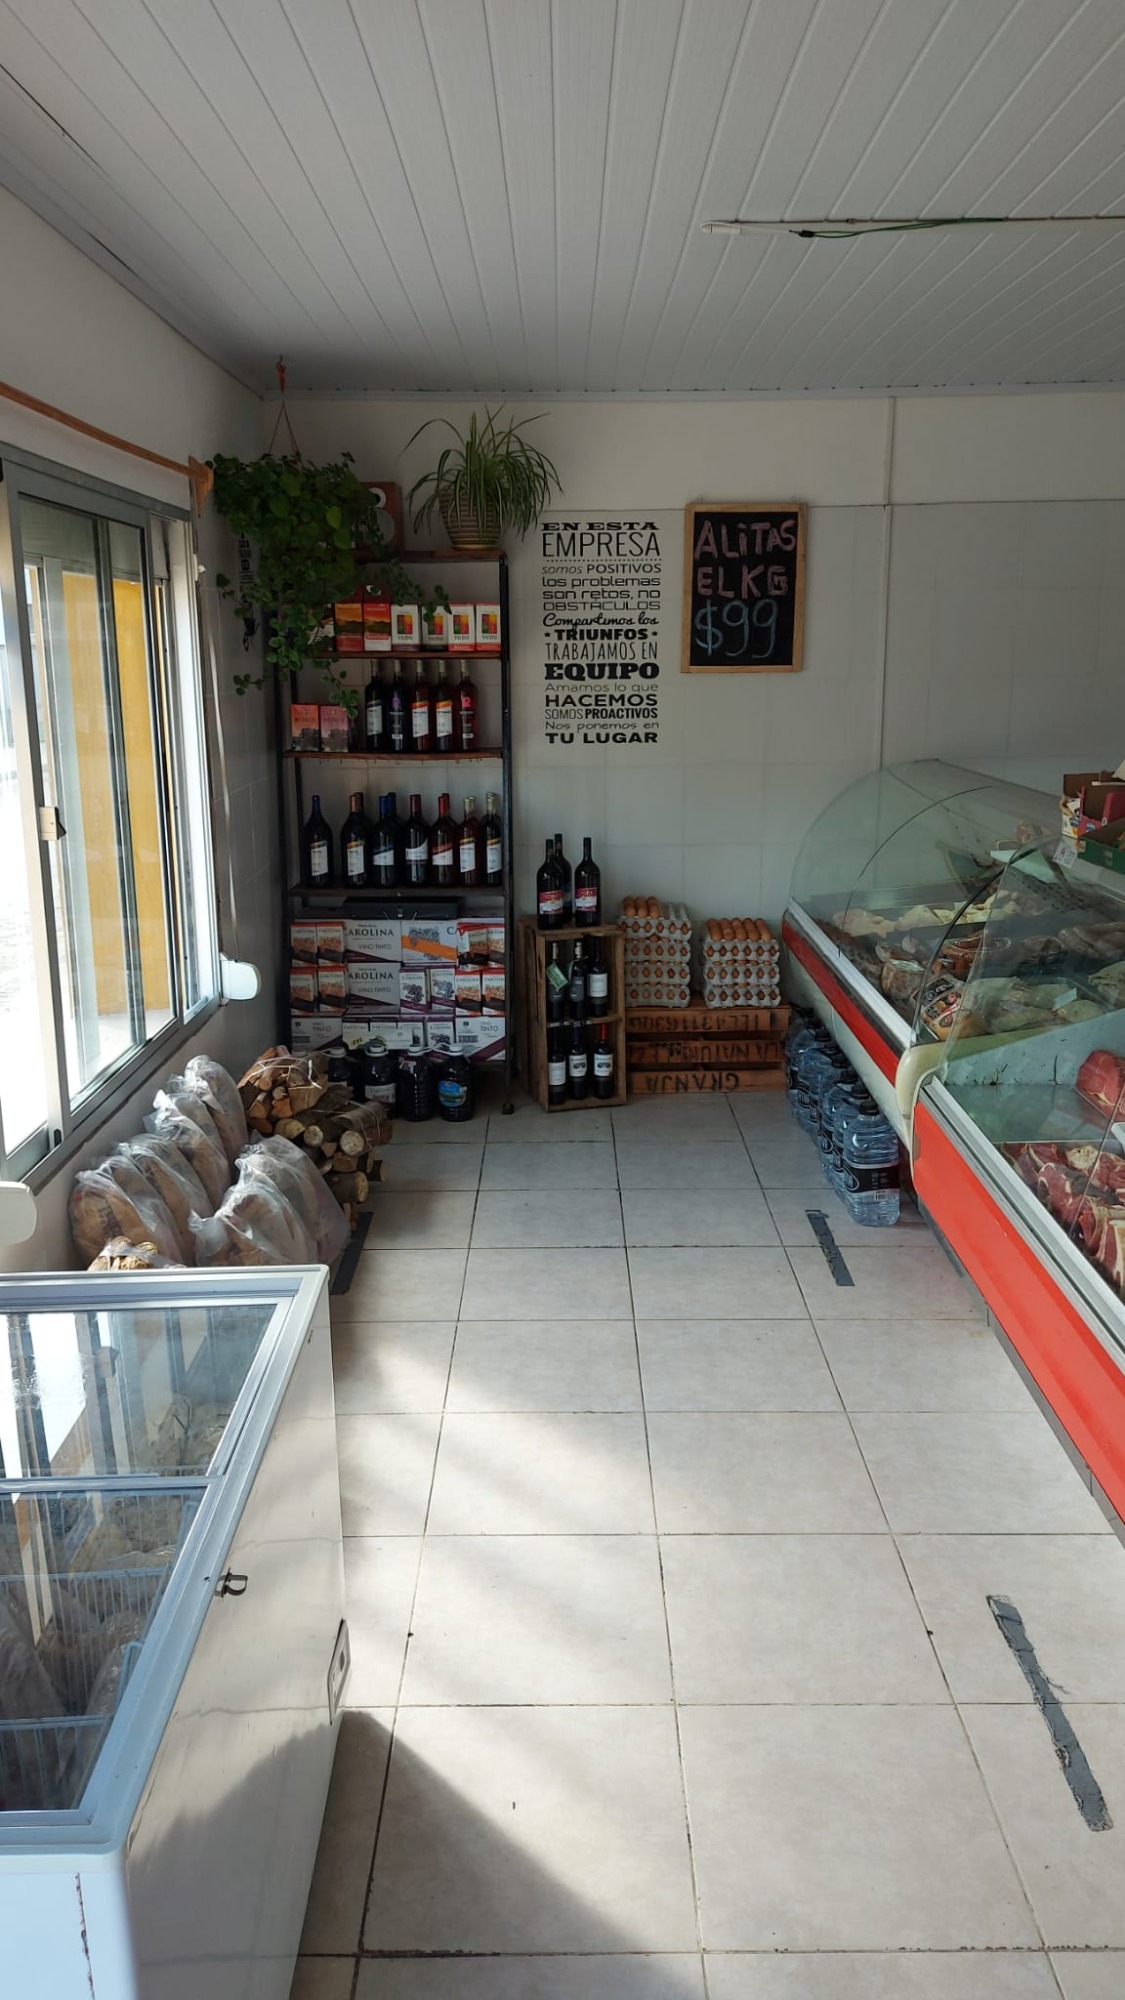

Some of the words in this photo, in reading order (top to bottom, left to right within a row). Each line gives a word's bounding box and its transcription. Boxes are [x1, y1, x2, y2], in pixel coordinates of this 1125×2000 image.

[541, 521, 580, 531] EN
[586, 521, 660, 531] ESTA
[542, 532, 661, 557] EMPRESA
[541, 564, 583, 575] somos
[586, 563, 662, 574] POSITIVOS
[542, 576, 568, 587] los
[571, 576, 661, 589] problemas
[542, 589, 576, 600] son
[581, 589, 634, 600] retos,
[637, 589, 661, 599] no
[542, 612, 636, 631] Compartimos
[638, 611, 660, 626] los
[554, 628, 648, 641] TRIUNFOS
[695, 599, 778, 660] $99
[545, 642, 636, 661] TRABAJAMOS
[641, 642, 658, 660] EN
[544, 663, 660, 681] EQUIPO
[545, 683, 610, 692] Amamos
[614, 683, 627, 692] lo
[631, 684, 659, 694] que
[545, 694, 658, 707] HACEMOS
[544, 708, 584, 720] SOMOS
[585, 707, 659, 720] PROACTIVOS
[545, 721, 571, 730] Nos
[577, 722, 637, 733] ponemos
[643, 721, 659, 730] en
[545, 732, 574, 744] TU
[582, 732, 658, 744] LUGAR
[645, 1072, 739, 1092] GRANJA
